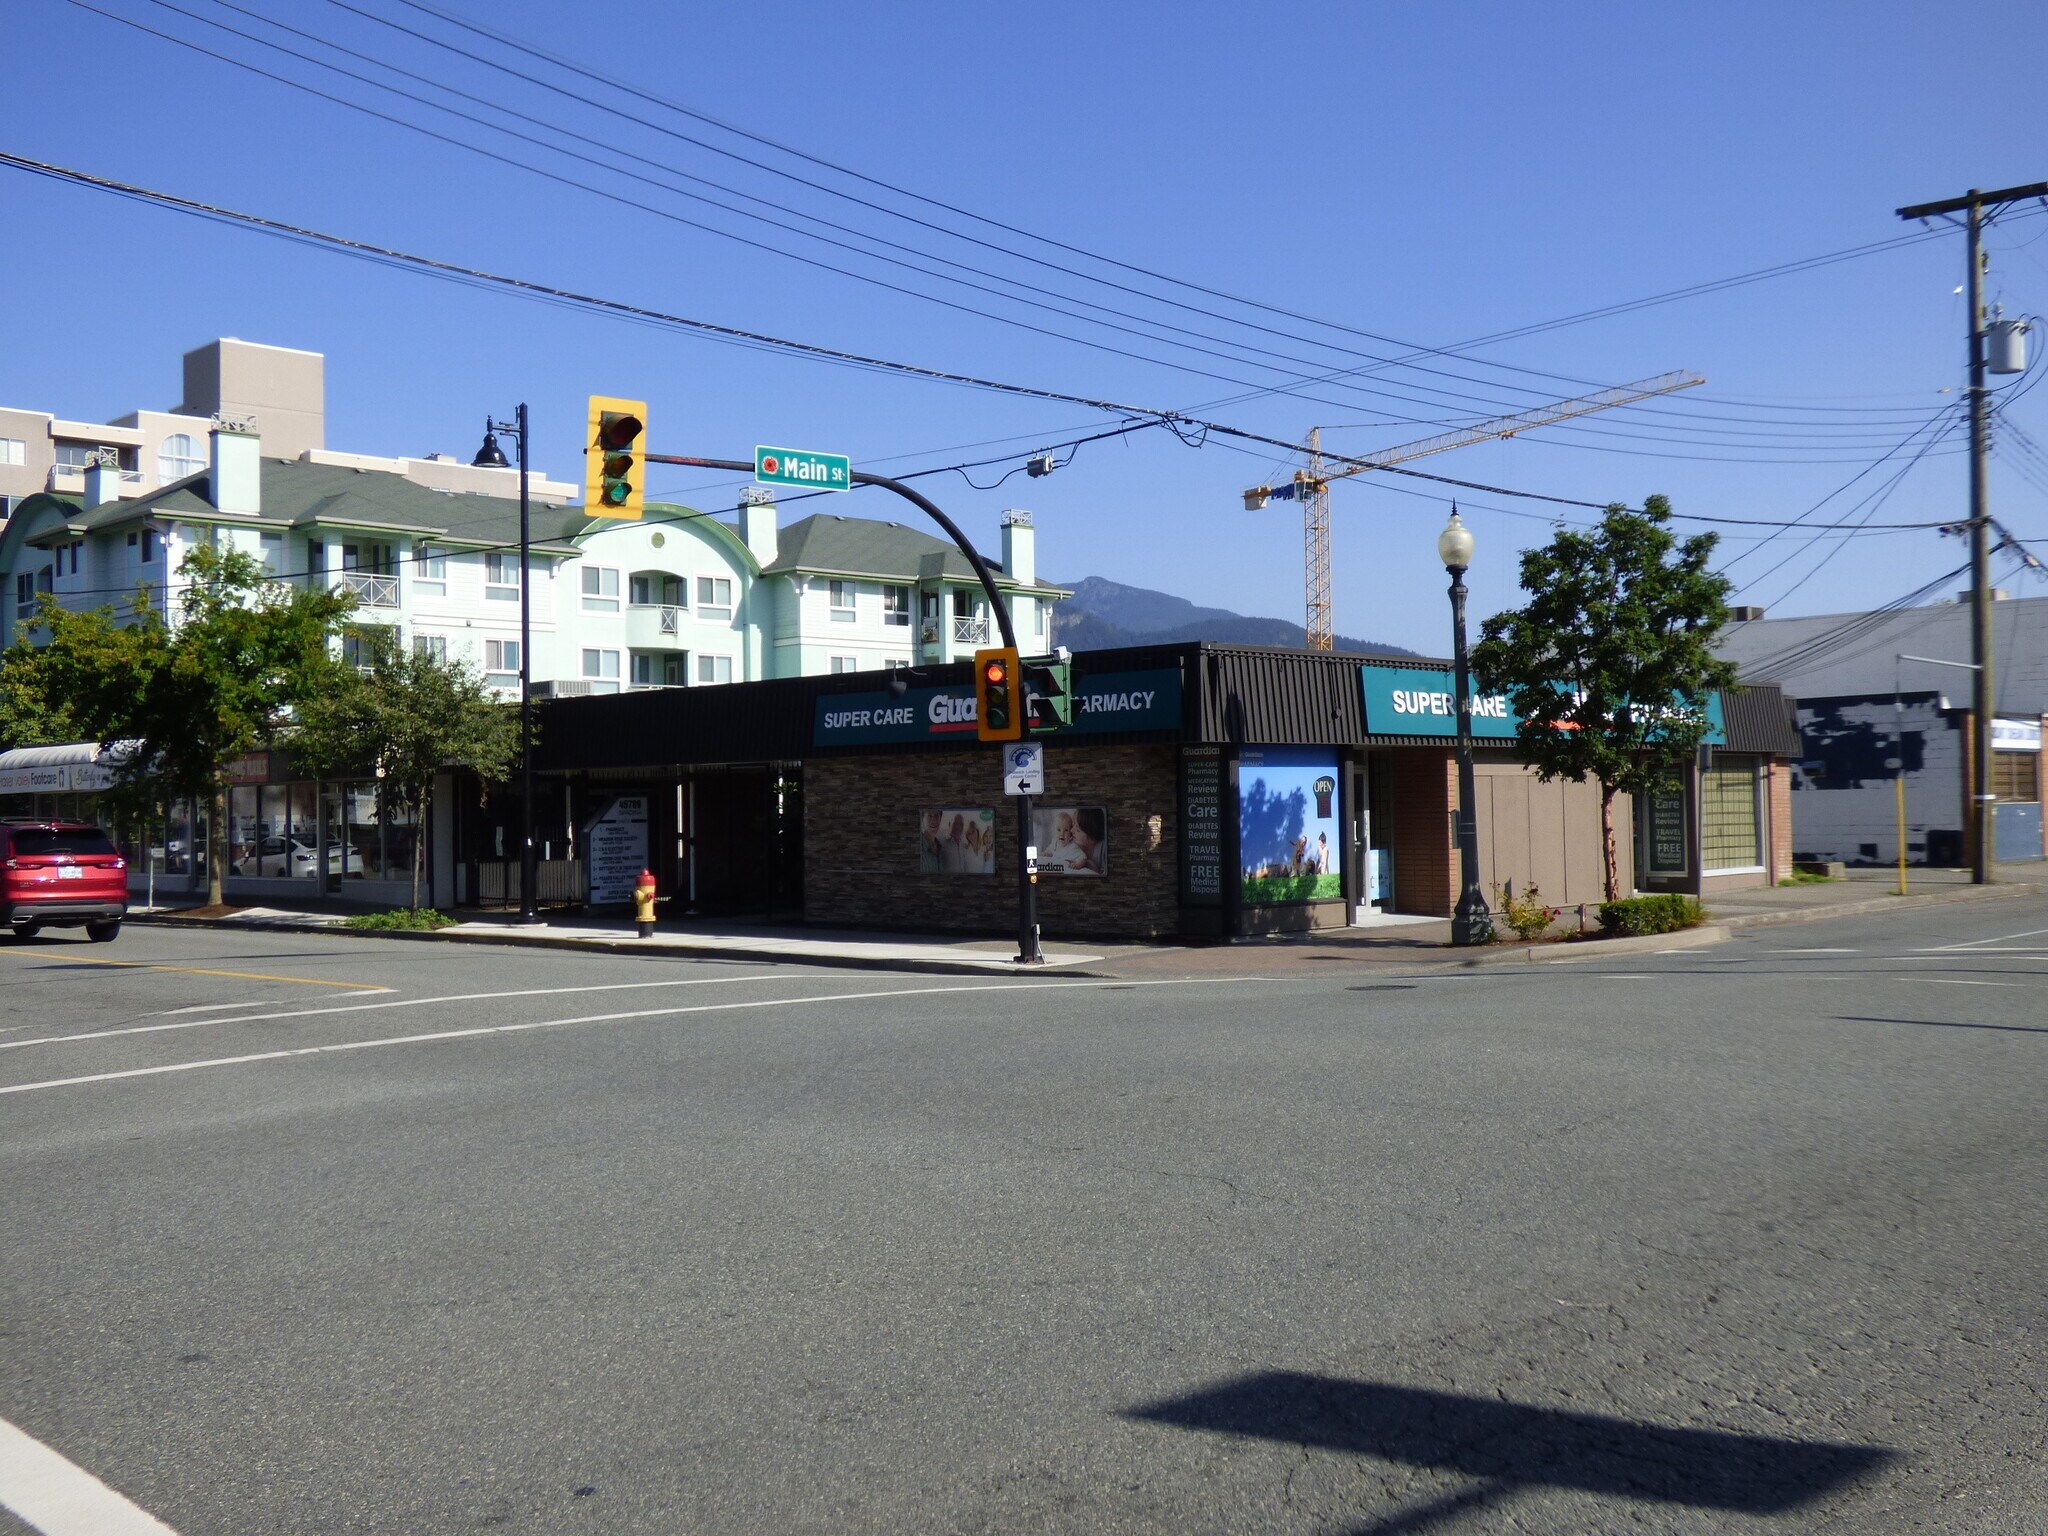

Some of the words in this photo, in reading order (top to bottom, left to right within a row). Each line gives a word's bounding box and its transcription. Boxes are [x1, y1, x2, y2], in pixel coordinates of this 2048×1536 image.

[784, 456, 827, 482] Main
[1392, 689, 1456, 715] SUPER
[1469, 694, 1508, 718] ARE
[824, 710, 871, 728] SUPER
[873, 707, 914, 725] CARE
[1074, 690, 1156, 714] ARMACY
[1182, 746, 1220, 756] Guardian
[31, 772, 57, 785] Footcare
[1187, 784, 1218, 793] Review
[1314, 780, 1332, 793] OPEN
[1187, 796, 1218, 804] DIABETES
[1655, 800, 1680, 809] Care
[1188, 804, 1218, 818] Care
[1655, 817, 1680, 825] Review
[1188, 822, 1219, 830] DIABETES
[1188, 830, 1218, 839] Review
[1189, 845, 1220, 854] TRAVEL
[1657, 843, 1681, 852] FREE
[1189, 854, 1220, 862] Pharmacy
[1037, 862, 1064, 872] ardian
[1191, 865, 1220, 878] FREE
[1190, 877, 1220, 886] Medical
[1191, 885, 1220, 895] Disposal
